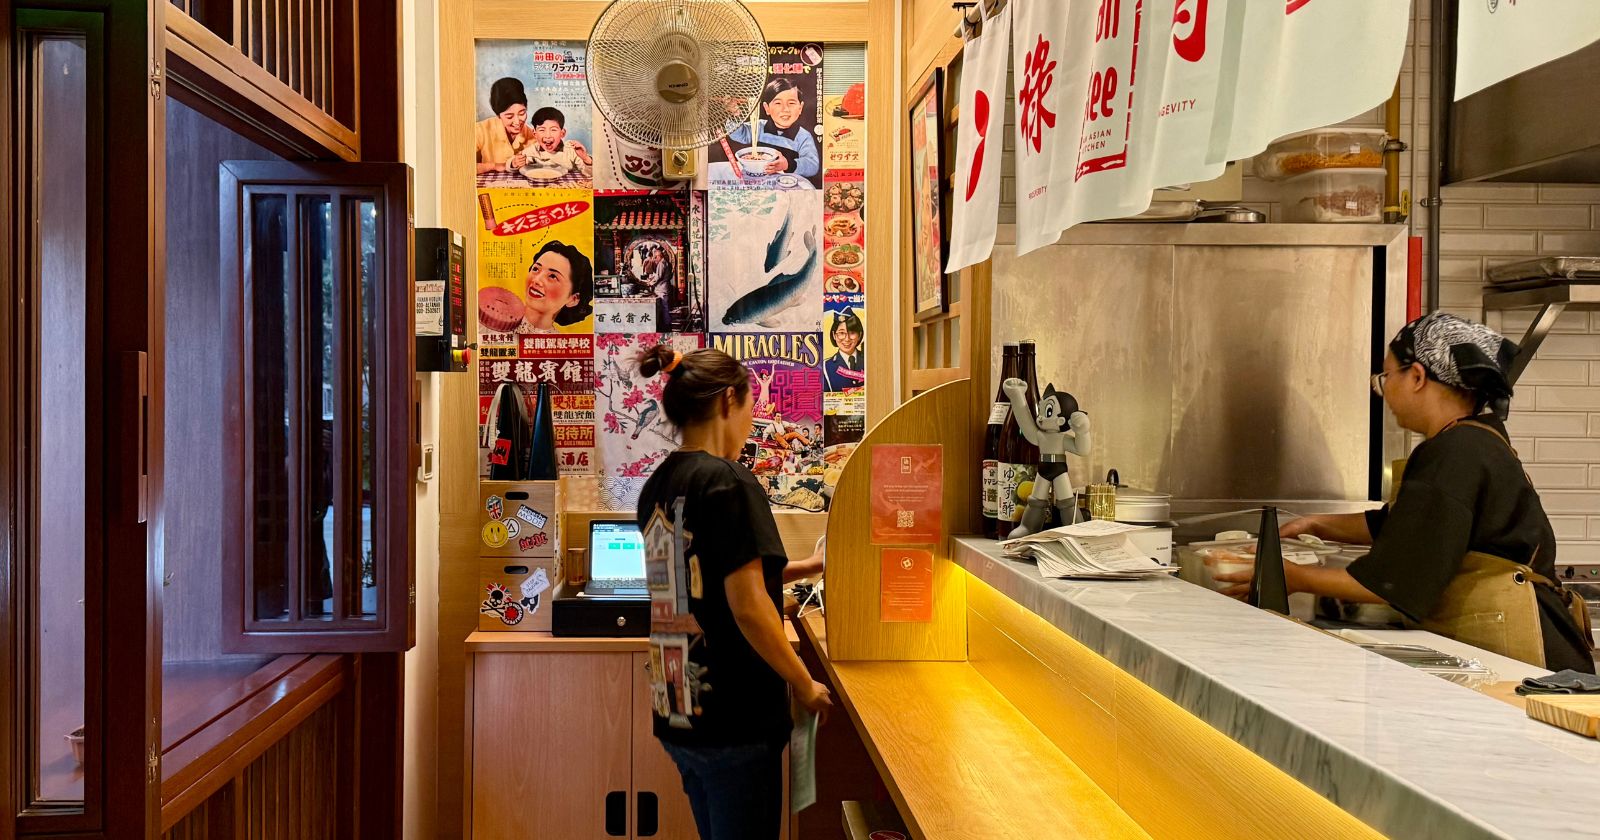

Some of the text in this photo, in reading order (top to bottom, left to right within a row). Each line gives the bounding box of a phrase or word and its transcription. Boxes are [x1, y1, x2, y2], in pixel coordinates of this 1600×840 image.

[551, 63, 585, 72] クラッカー
[1086, 67, 1118, 121] ee
[1089, 128, 1112, 140] ASIAN
[713, 334, 819, 367] MIRACLES
[490, 360, 583, 383] 雙龍賓館
[558, 452, 589, 466] 酒店
[1003, 467, 1018, 518] ゆず酢
[517, 511, 544, 527] MODE
